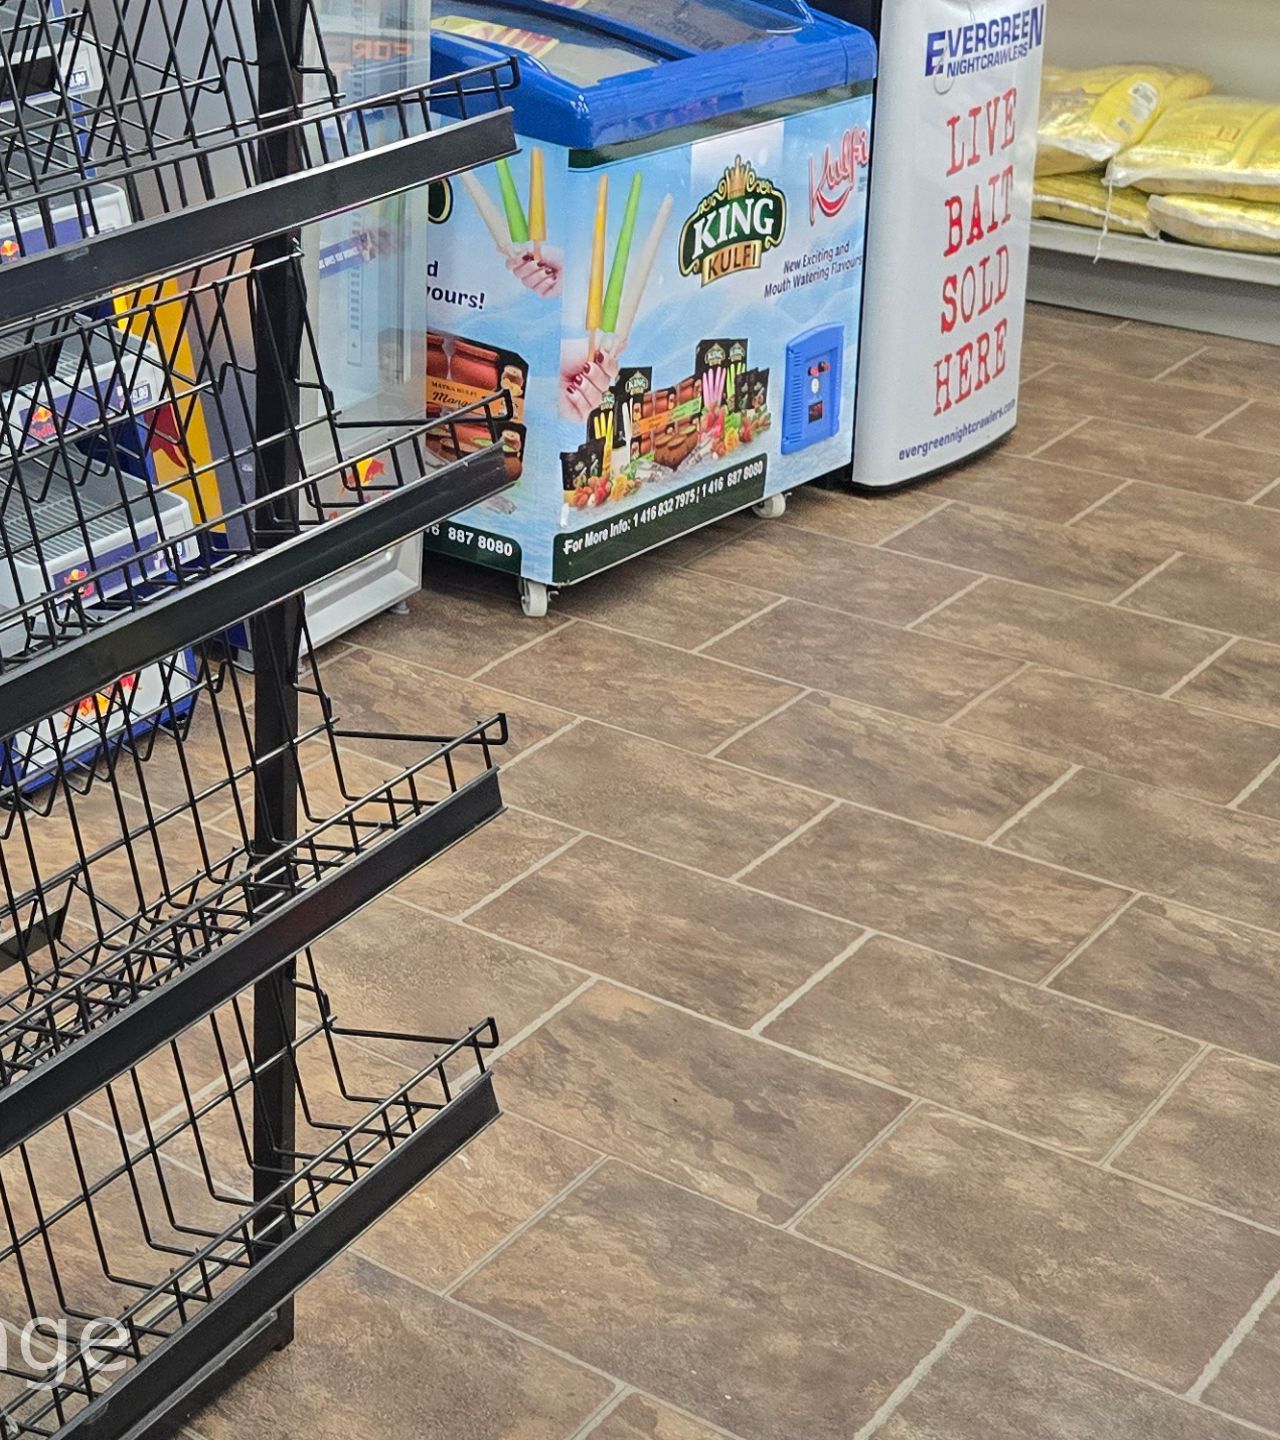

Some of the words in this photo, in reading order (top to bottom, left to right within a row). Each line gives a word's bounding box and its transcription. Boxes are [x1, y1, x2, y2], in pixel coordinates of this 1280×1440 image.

[925, 4, 1045, 77] EVERGREEN
[947, 41, 1029, 78] NIGHTCRAWLERS
[946, 87, 1017, 177] LIVE
[692, 197, 775, 259] KING
[943, 164, 1014, 258] BAIT
[708, 244, 757, 279] KULFI
[764, 278, 791, 298] Mouth
[793, 266, 830, 289] Watering
[784, 259, 801, 274] New
[803, 250, 833, 268] Exciting
[835, 241, 850, 257] and
[941, 244, 1009, 334] SOLD
[933, 318, 1008, 417] HERE
[898, 398, 1017, 461] evergreennightcrawlers.com
[447, 524, 475, 547] 887
[478, 534, 514, 558] 8080
[563, 538, 584, 555] For
[586, 529, 608, 547] More
[610, 520, 631, 537] Info:
[640, 505, 657, 523] 416
[657, 498, 674, 517] 832
[675, 488, 696, 510] 7975
[709, 476, 724, 495] 416
